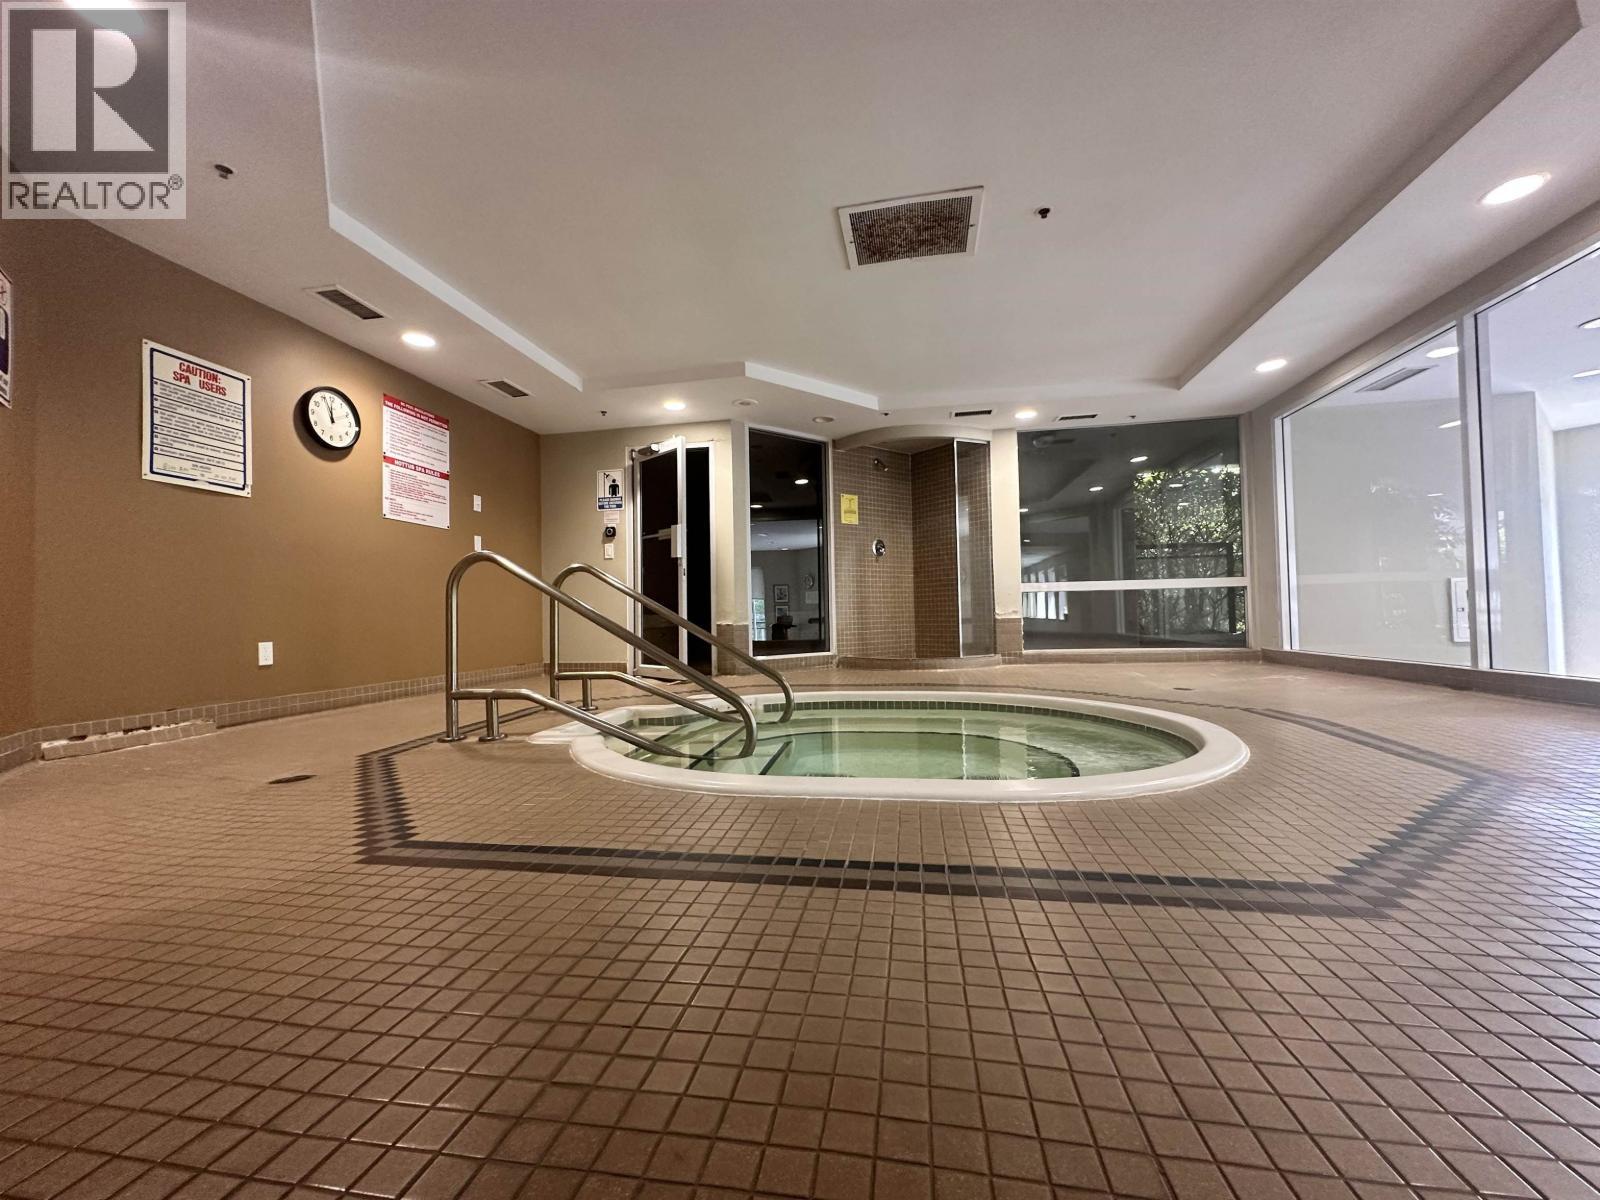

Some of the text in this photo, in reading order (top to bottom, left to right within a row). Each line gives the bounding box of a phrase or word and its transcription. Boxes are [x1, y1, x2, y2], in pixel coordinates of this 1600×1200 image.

[173, 371, 227, 396] SPA USERS
[179, 362, 221, 385] CAUTION:
